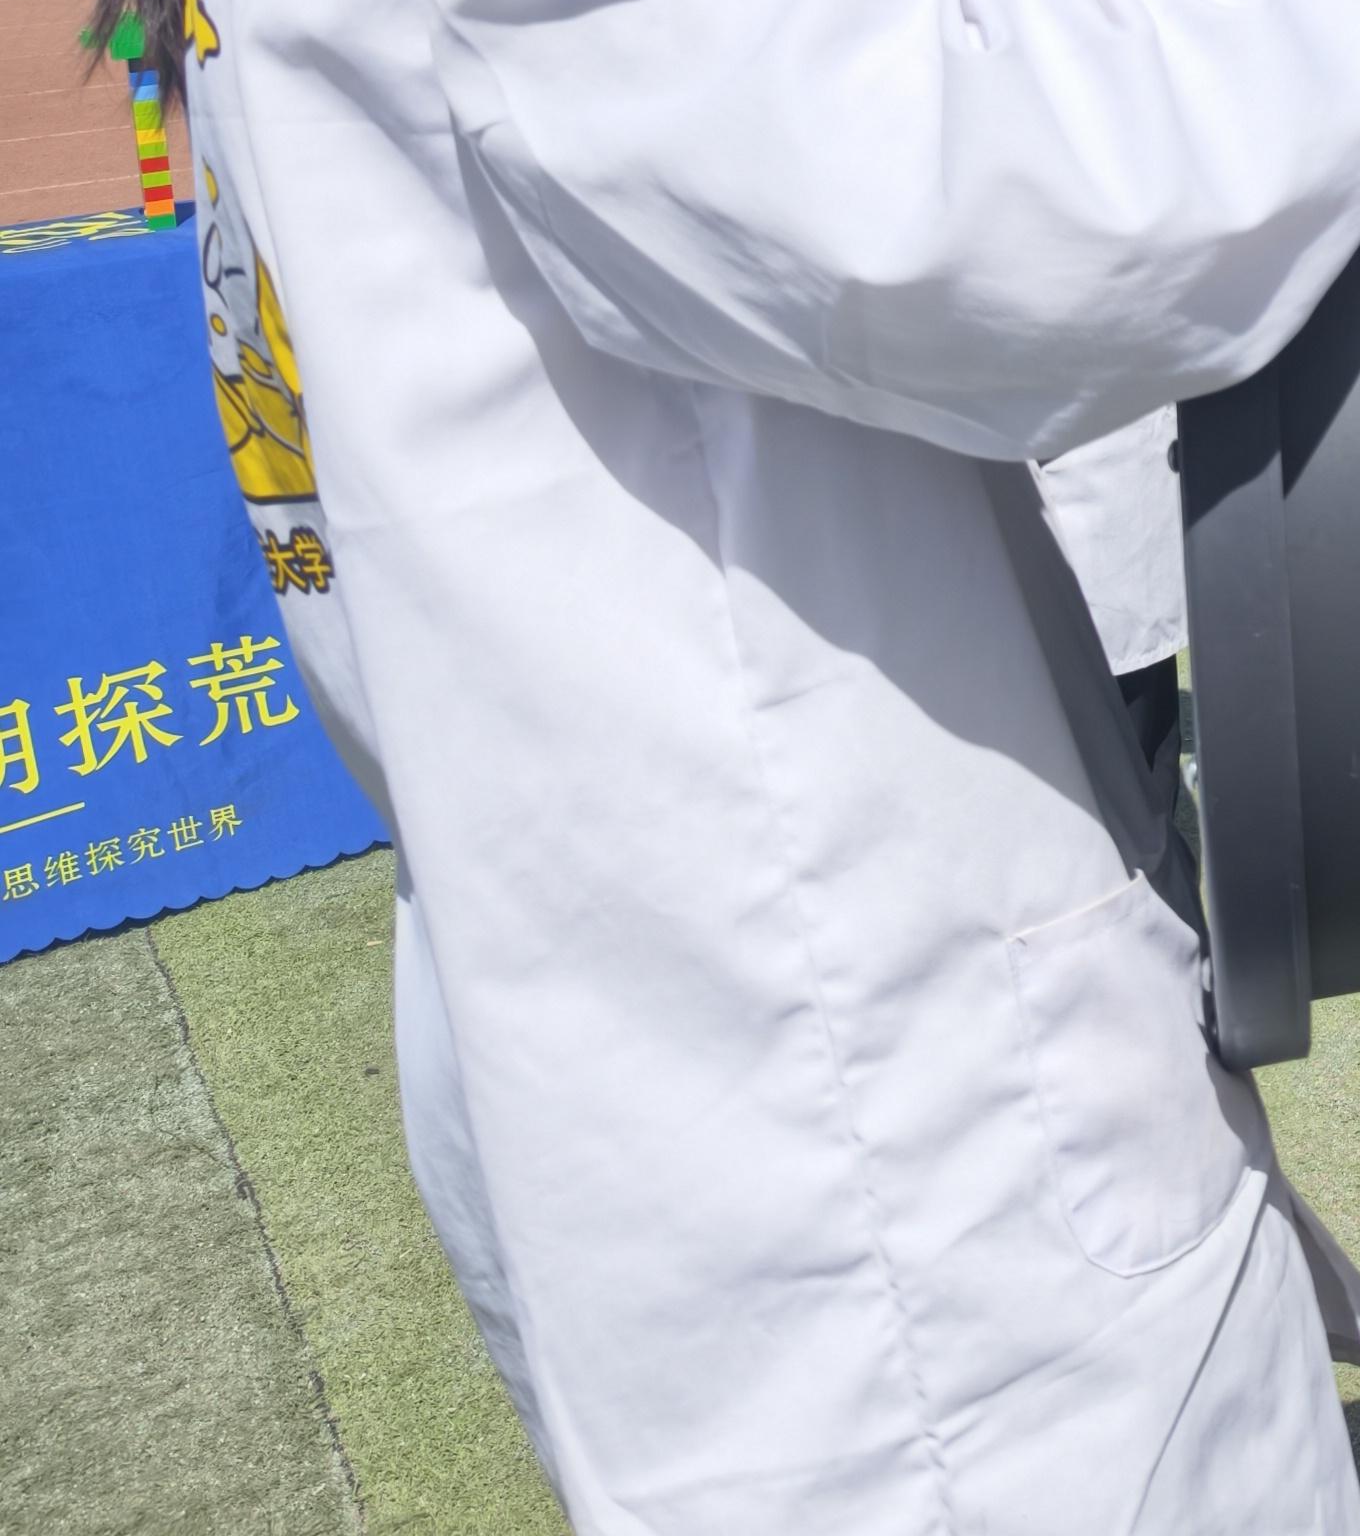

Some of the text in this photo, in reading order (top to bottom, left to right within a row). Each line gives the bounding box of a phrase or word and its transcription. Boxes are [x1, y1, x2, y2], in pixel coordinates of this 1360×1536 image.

[255, 526, 334, 595] 大学
[2, 803, 244, 901] 思维探究世界
